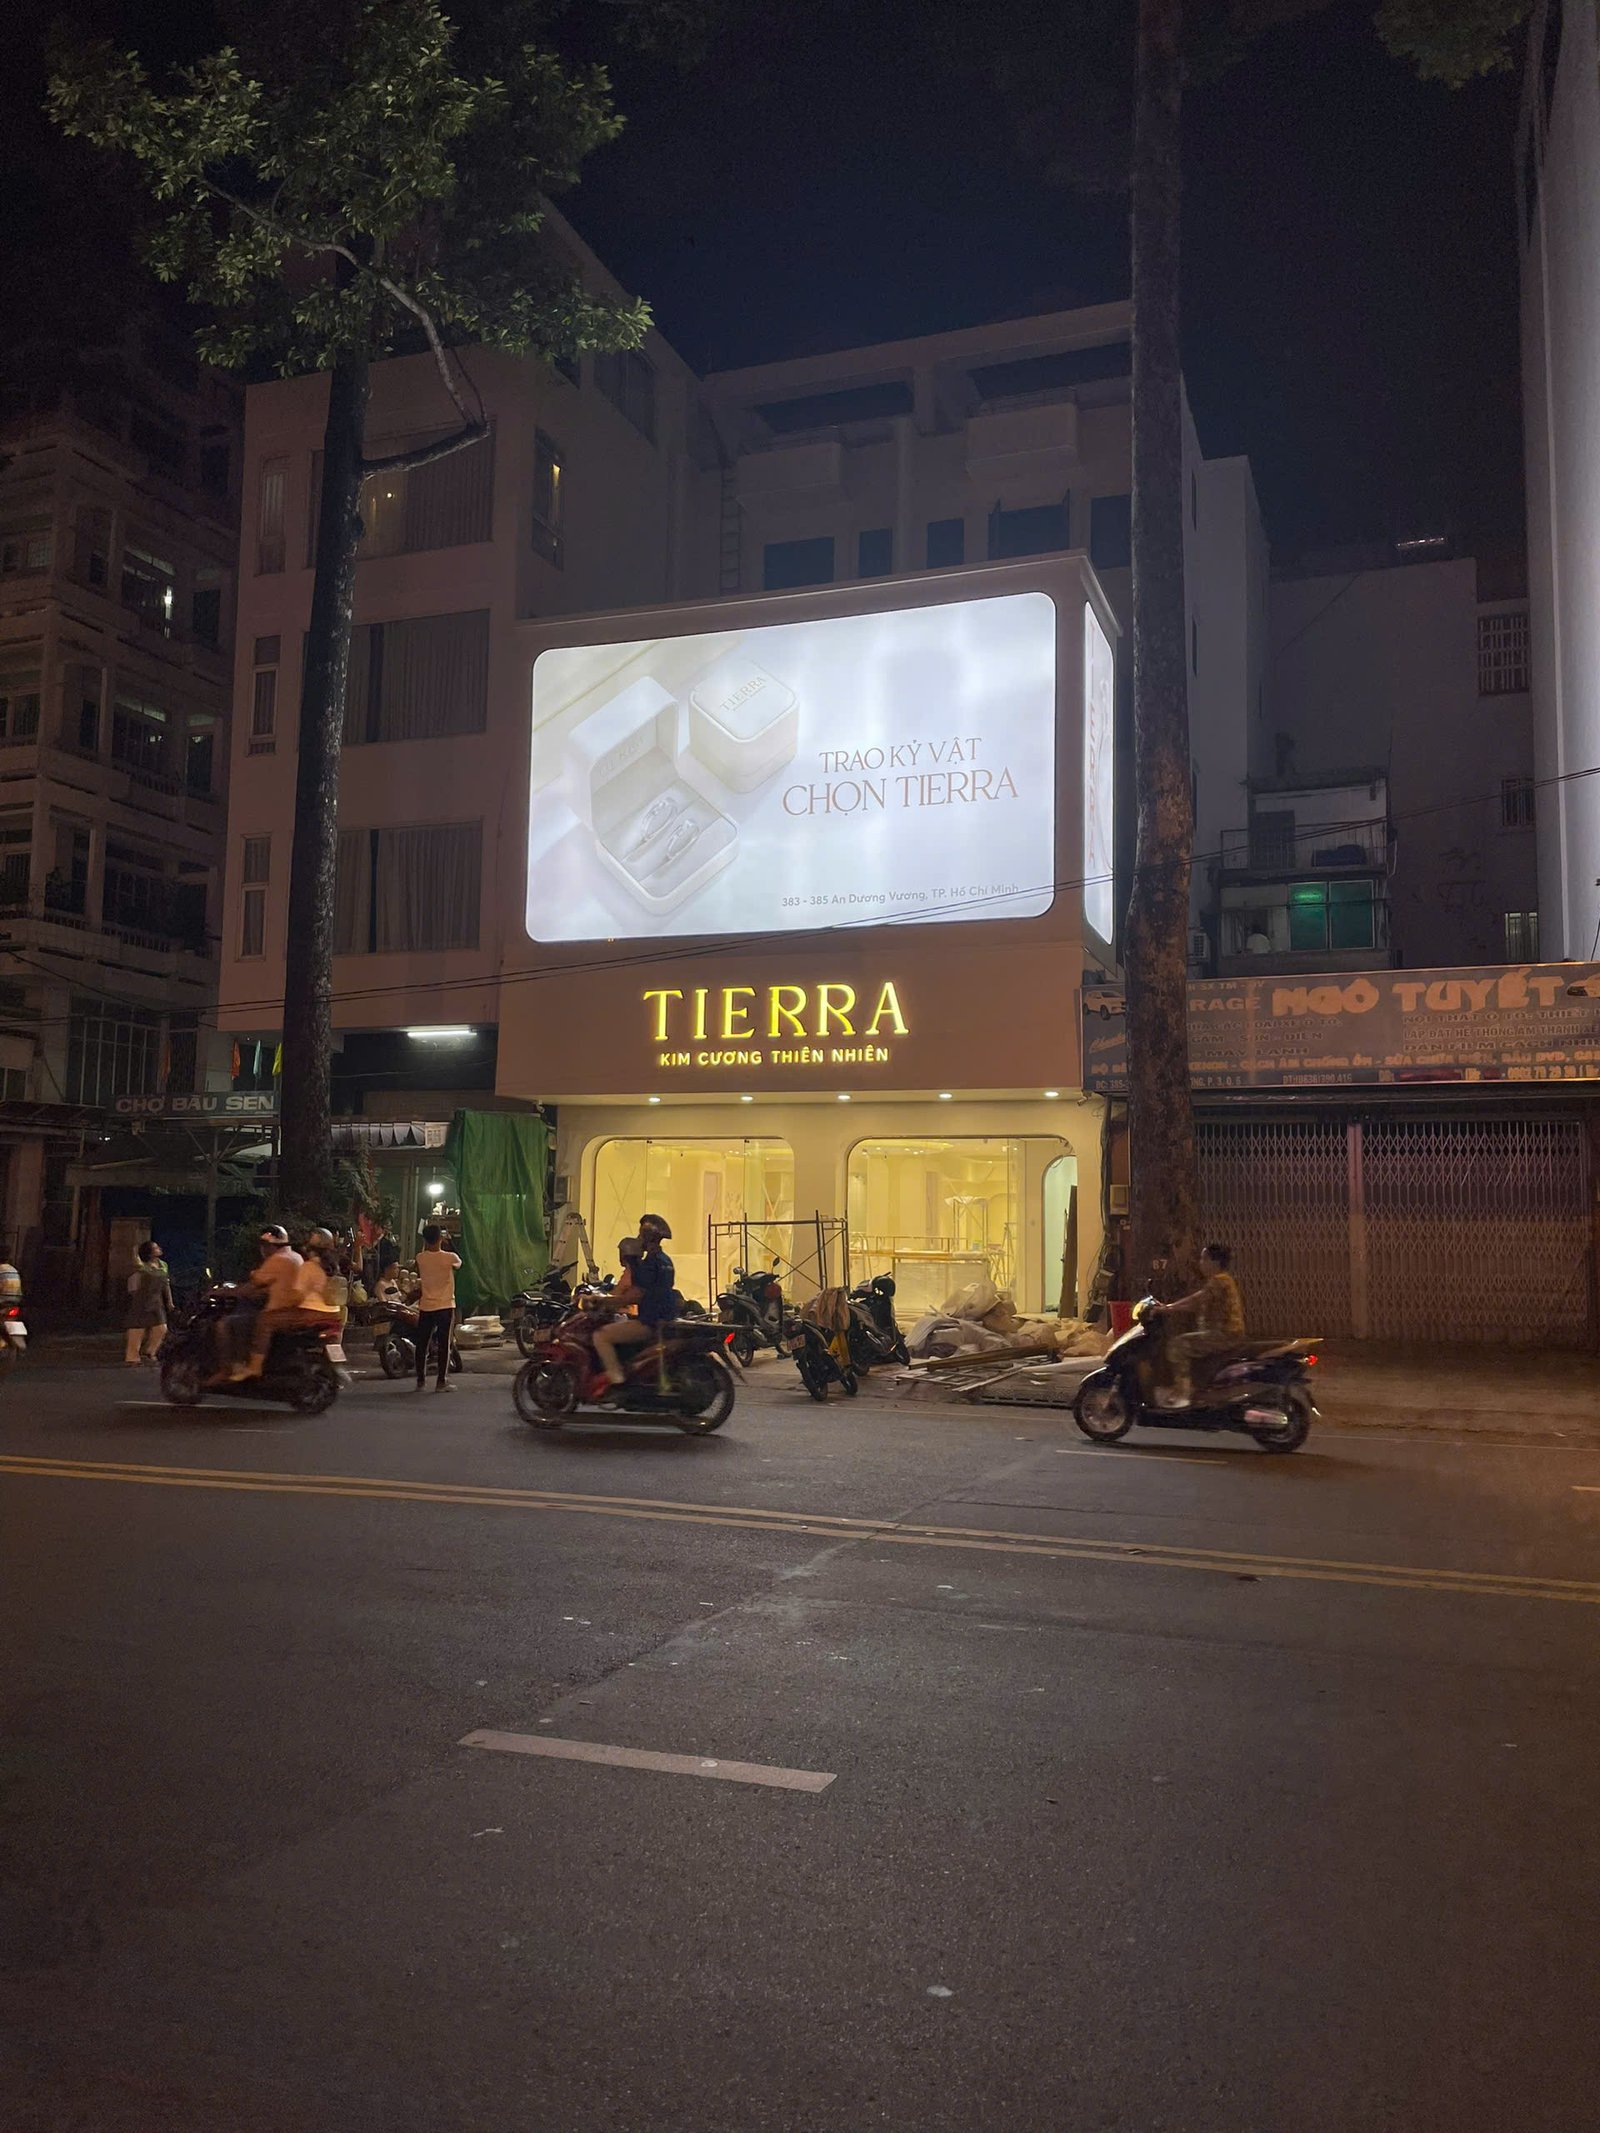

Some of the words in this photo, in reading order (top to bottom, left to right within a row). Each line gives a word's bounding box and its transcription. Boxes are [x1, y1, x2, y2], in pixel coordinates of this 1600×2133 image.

[719, 676, 767, 711] TIERRA
[819, 747, 885, 774] TRAO
[890, 739, 923, 768] KỶ
[928, 736, 982, 765] VẬT
[782, 778, 887, 816] CHỌN
[896, 766, 1019, 808] TIERRA
[782, 897, 801, 908] 383
[809, 895, 829, 906] 385
[849, 893, 886, 904] Dương
[950, 885, 967, 897] Hồ
[991, 883, 1019, 895] Minh
[1190, 996, 1261, 1011] RAGE
[1272, 978, 1380, 1017] NGÔ
[1392, 967, 1565, 1013] TUYẾT
[643, 982, 909, 1040] TIERRA
[1540, 1022, 1580, 1035] THANH
[660, 1052, 691, 1066] KIM
[698, 1050, 762, 1065] CƯƠNG
[772, 1046, 824, 1063] THIÊN
[832, 1044, 889, 1062] NHIÊN
[115, 1095, 166, 1114] CHỢ
[225, 1095, 274, 1111] SEN
